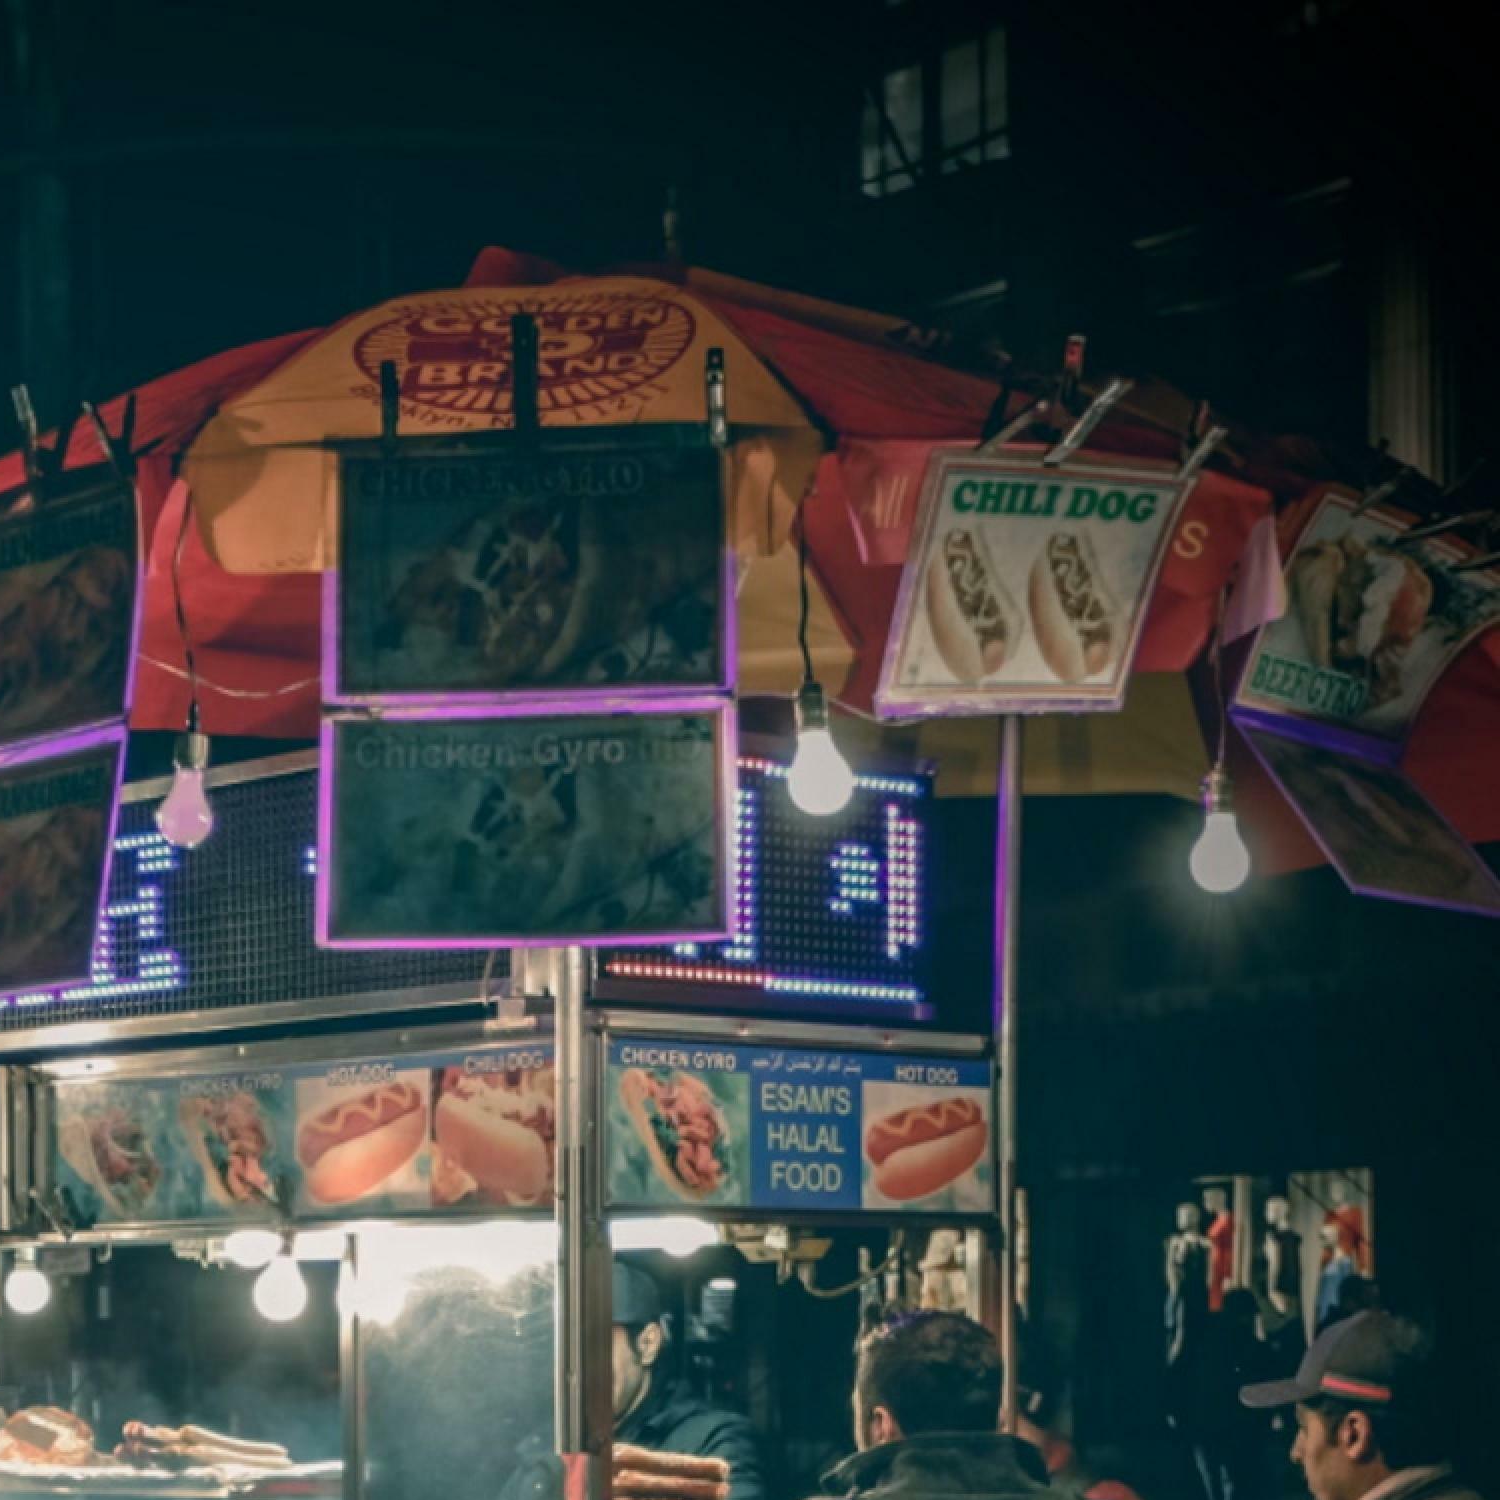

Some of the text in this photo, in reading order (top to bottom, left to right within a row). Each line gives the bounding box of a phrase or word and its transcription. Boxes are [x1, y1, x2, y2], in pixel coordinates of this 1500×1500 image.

[952, 479, 1159, 524] CHILI DOG
[354, 734, 516, 770] Chicken
[531, 731, 627, 773] Gyro
[620, 1046, 737, 1072] CHICKEN GYRO
[894, 1065, 959, 1085] HOT DOG
[760, 1082, 852, 1116] ESAM'S
[767, 1122, 845, 1154] HALAL
[770, 1161, 842, 1192] FOOD
